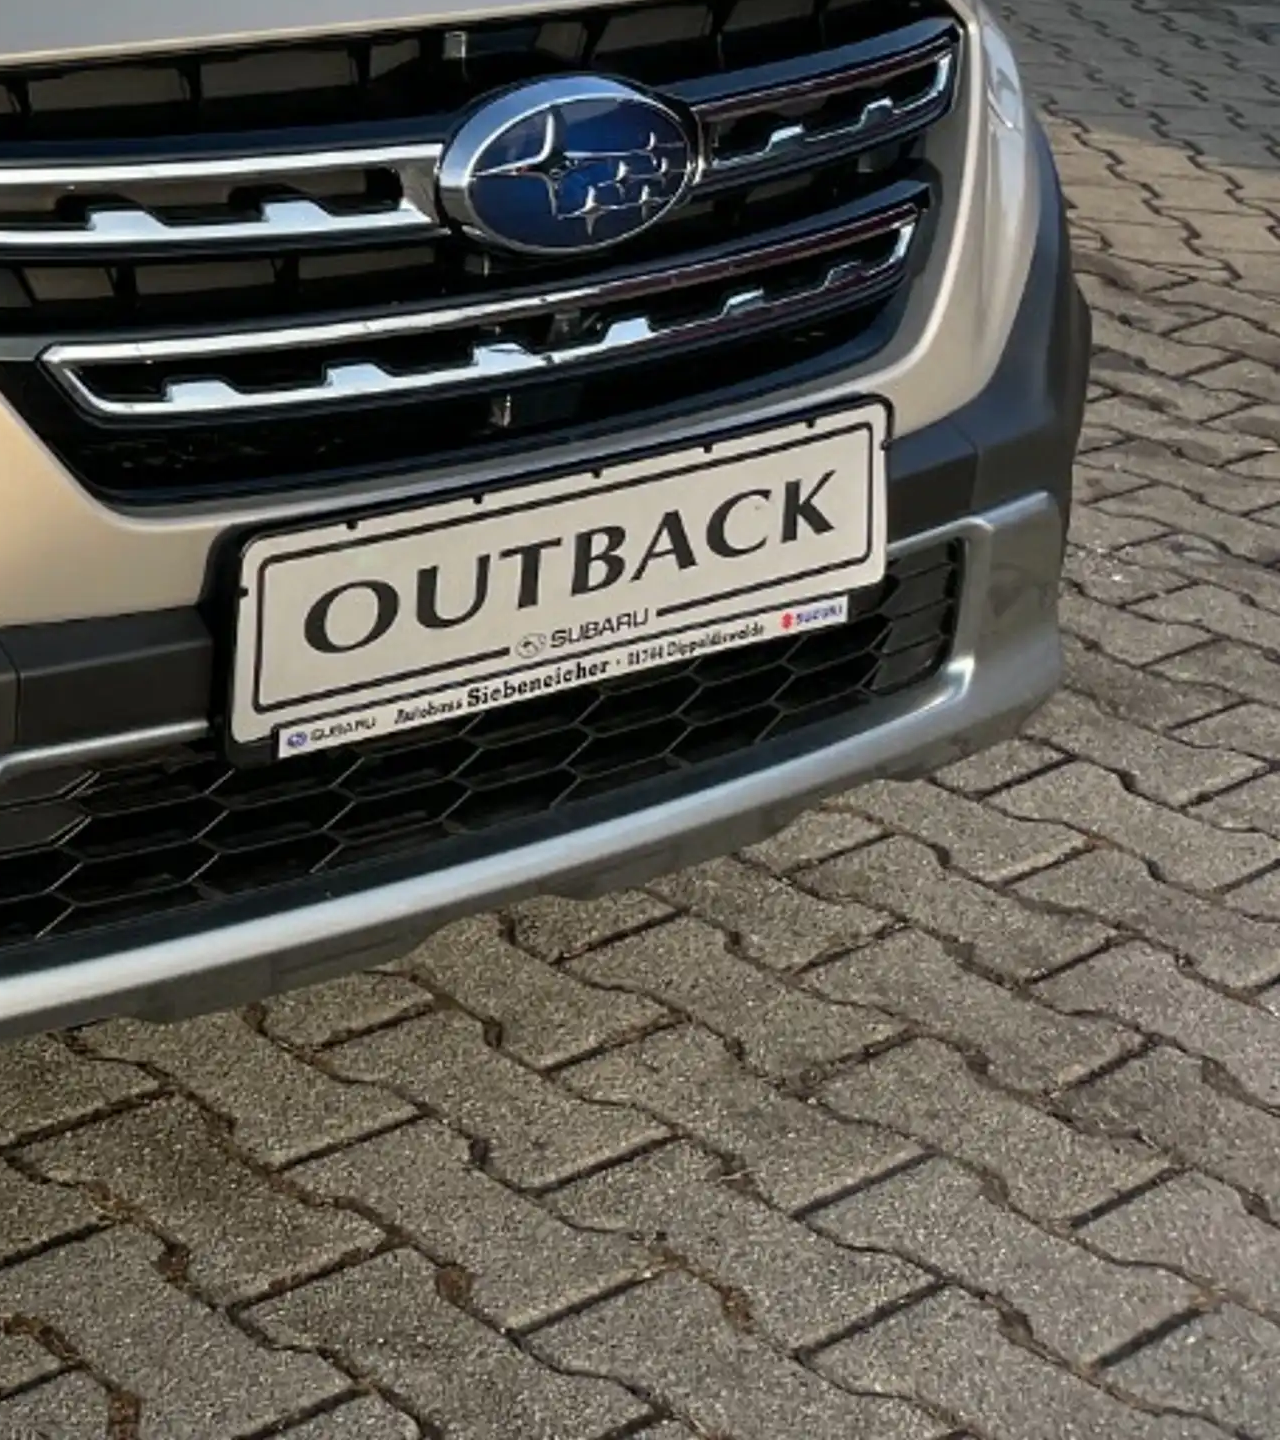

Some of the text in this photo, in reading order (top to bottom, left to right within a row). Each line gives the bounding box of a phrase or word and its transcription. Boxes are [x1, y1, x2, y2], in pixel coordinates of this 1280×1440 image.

[303, 469, 837, 654] OUTBACK
[549, 608, 649, 648] SUBARU
[467, 658, 610, 707] Siebeneicher
